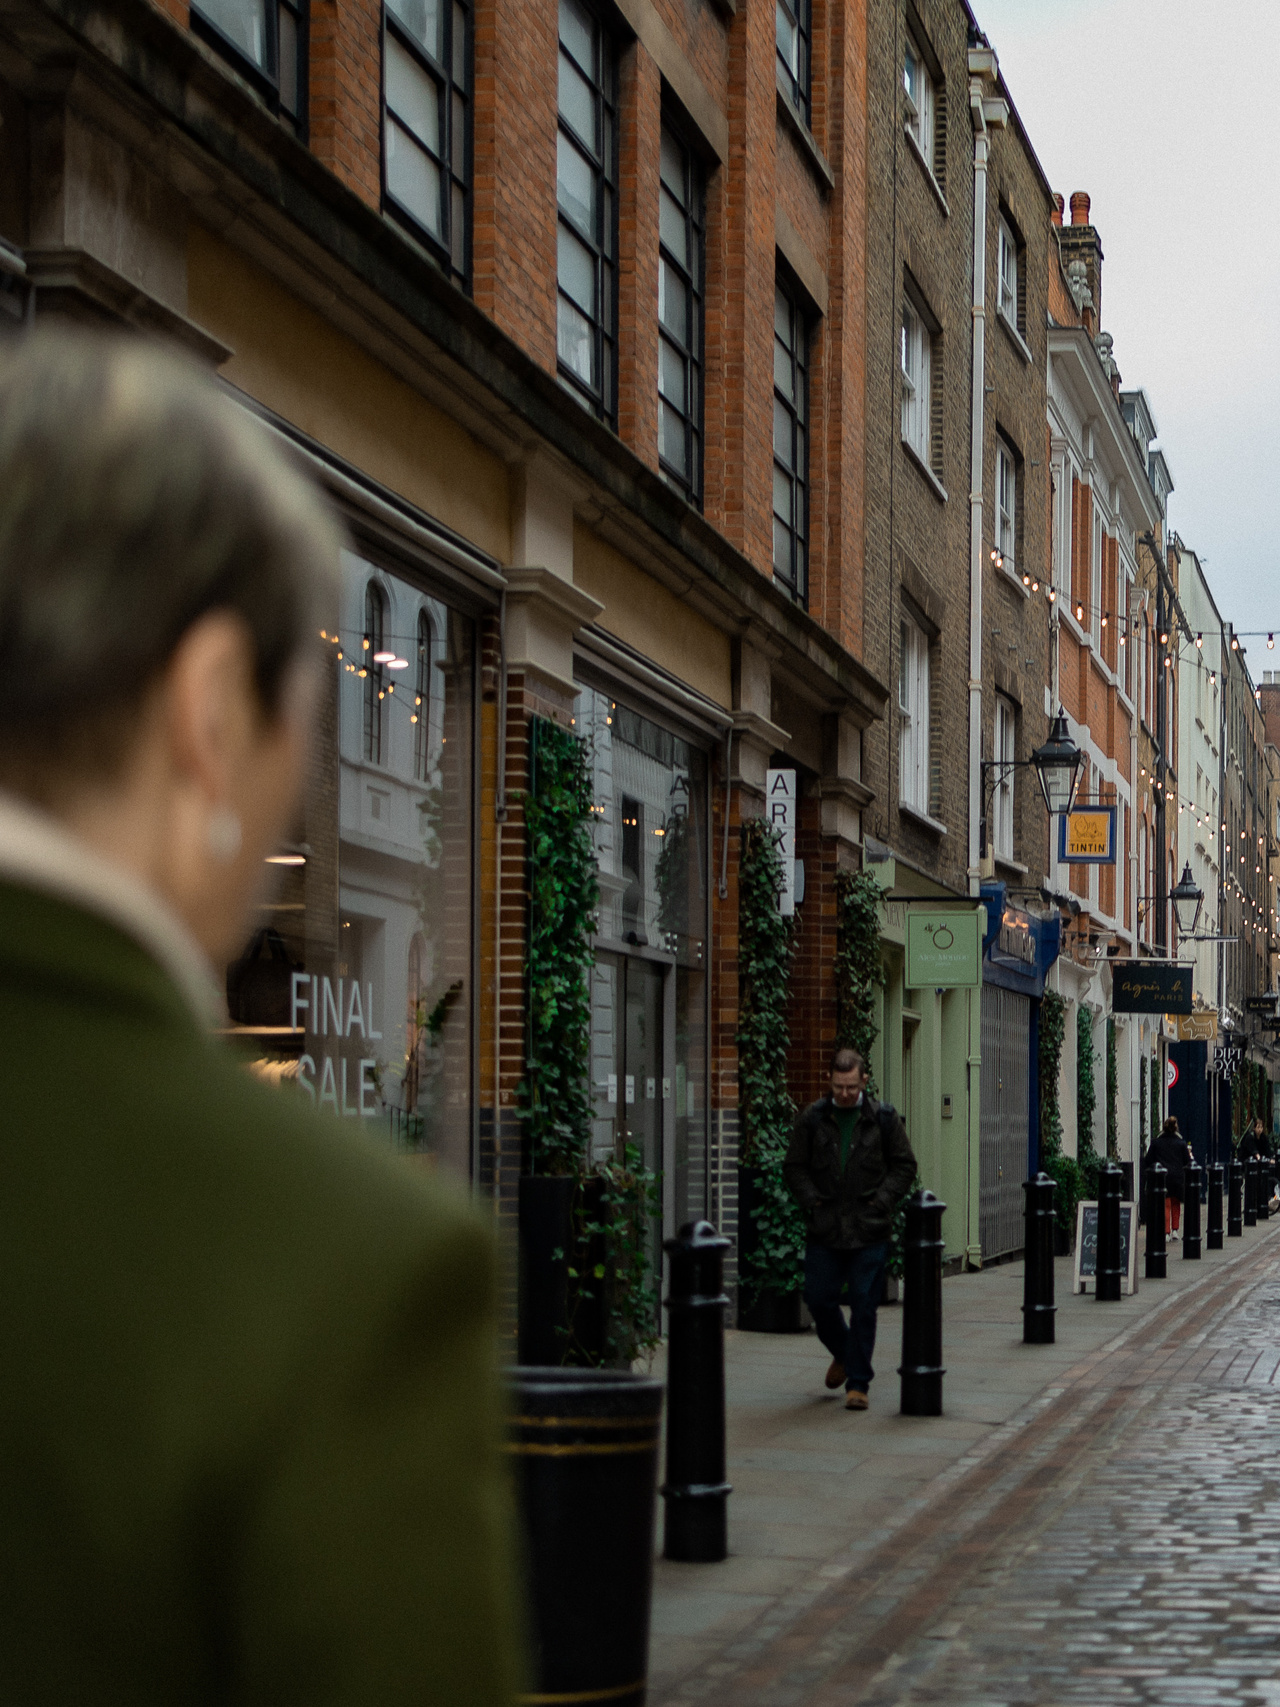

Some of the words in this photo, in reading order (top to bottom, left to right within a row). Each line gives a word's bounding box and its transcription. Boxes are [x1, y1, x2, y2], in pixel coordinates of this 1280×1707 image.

[1070, 843, 1105, 853] TINTIN
[291, 972, 383, 1040] FINAL
[298, 1053, 376, 1117] SALE
